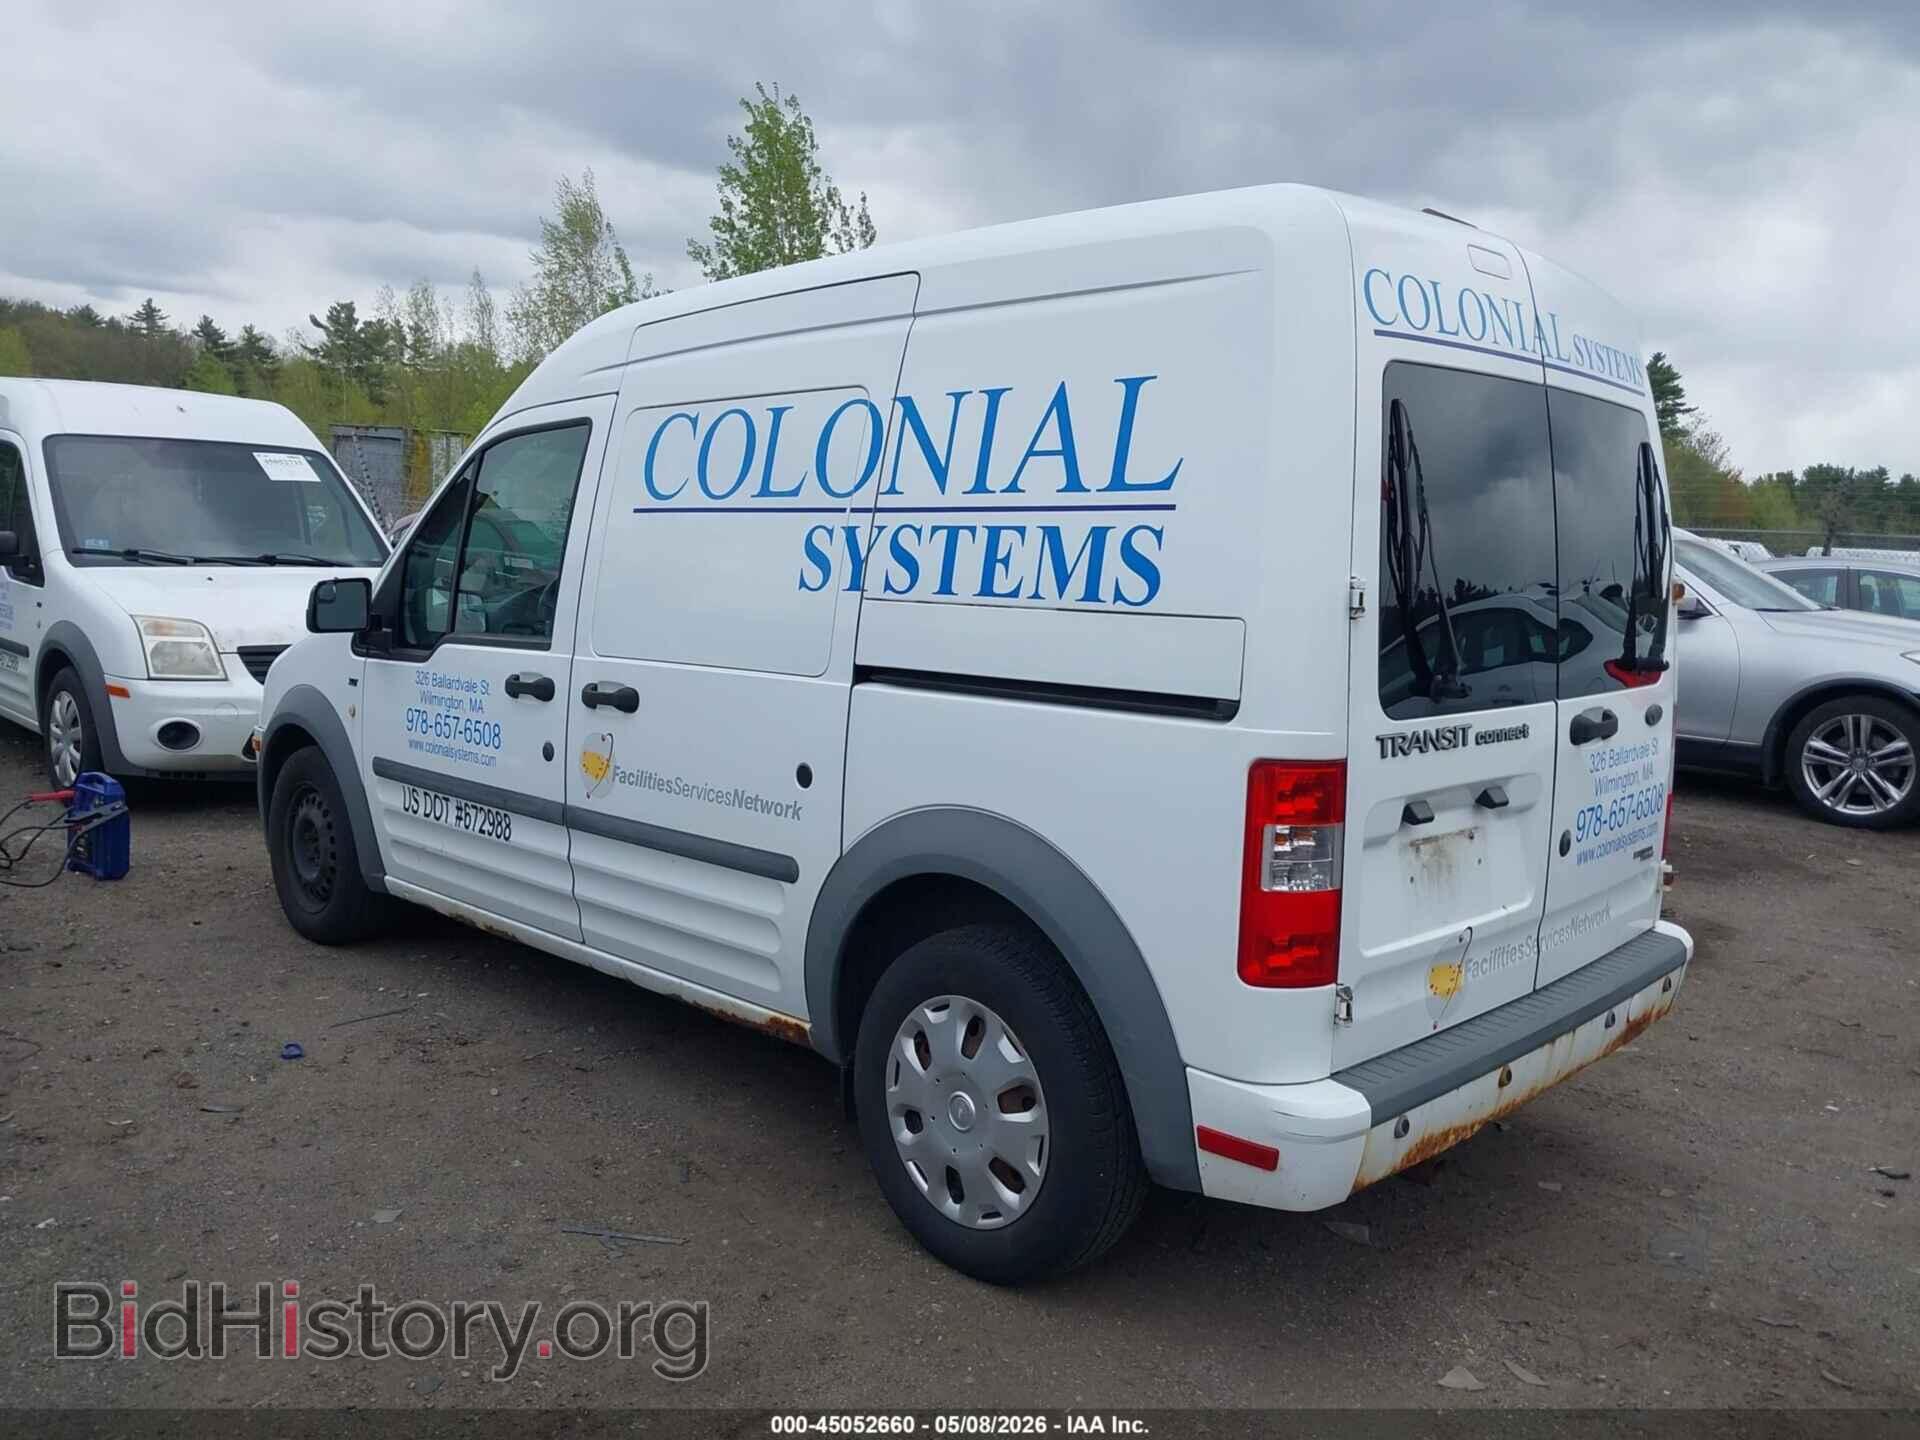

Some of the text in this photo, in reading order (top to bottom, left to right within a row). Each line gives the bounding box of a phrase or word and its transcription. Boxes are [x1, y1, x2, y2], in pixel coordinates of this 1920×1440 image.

[1363, 268, 1645, 387] COLONIAL SYSTEMS
[643, 375, 1184, 502] COLONIAL
[798, 524, 1165, 606] SYSTEMS
[415, 670, 430, 687] 326
[431, 673, 478, 694] Ballardvale
[419, 690, 484, 714] Wilmington, MA
[406, 708, 502, 750] 978-657-6508
[1376, 723, 1530, 760] TRANSIT connect
[408, 738, 498, 768] www.colonialsystems.com
[1589, 751, 1607, 774] 326
[1608, 741, 1650, 768] Ballardvale
[402, 786, 512, 842] US DOT #672988
[612, 764, 803, 822] FacilitiesServicesNetwork
[1575, 782, 1664, 843] 978-657-6508
[1576, 821, 1658, 866] www.colonialsystems.com
